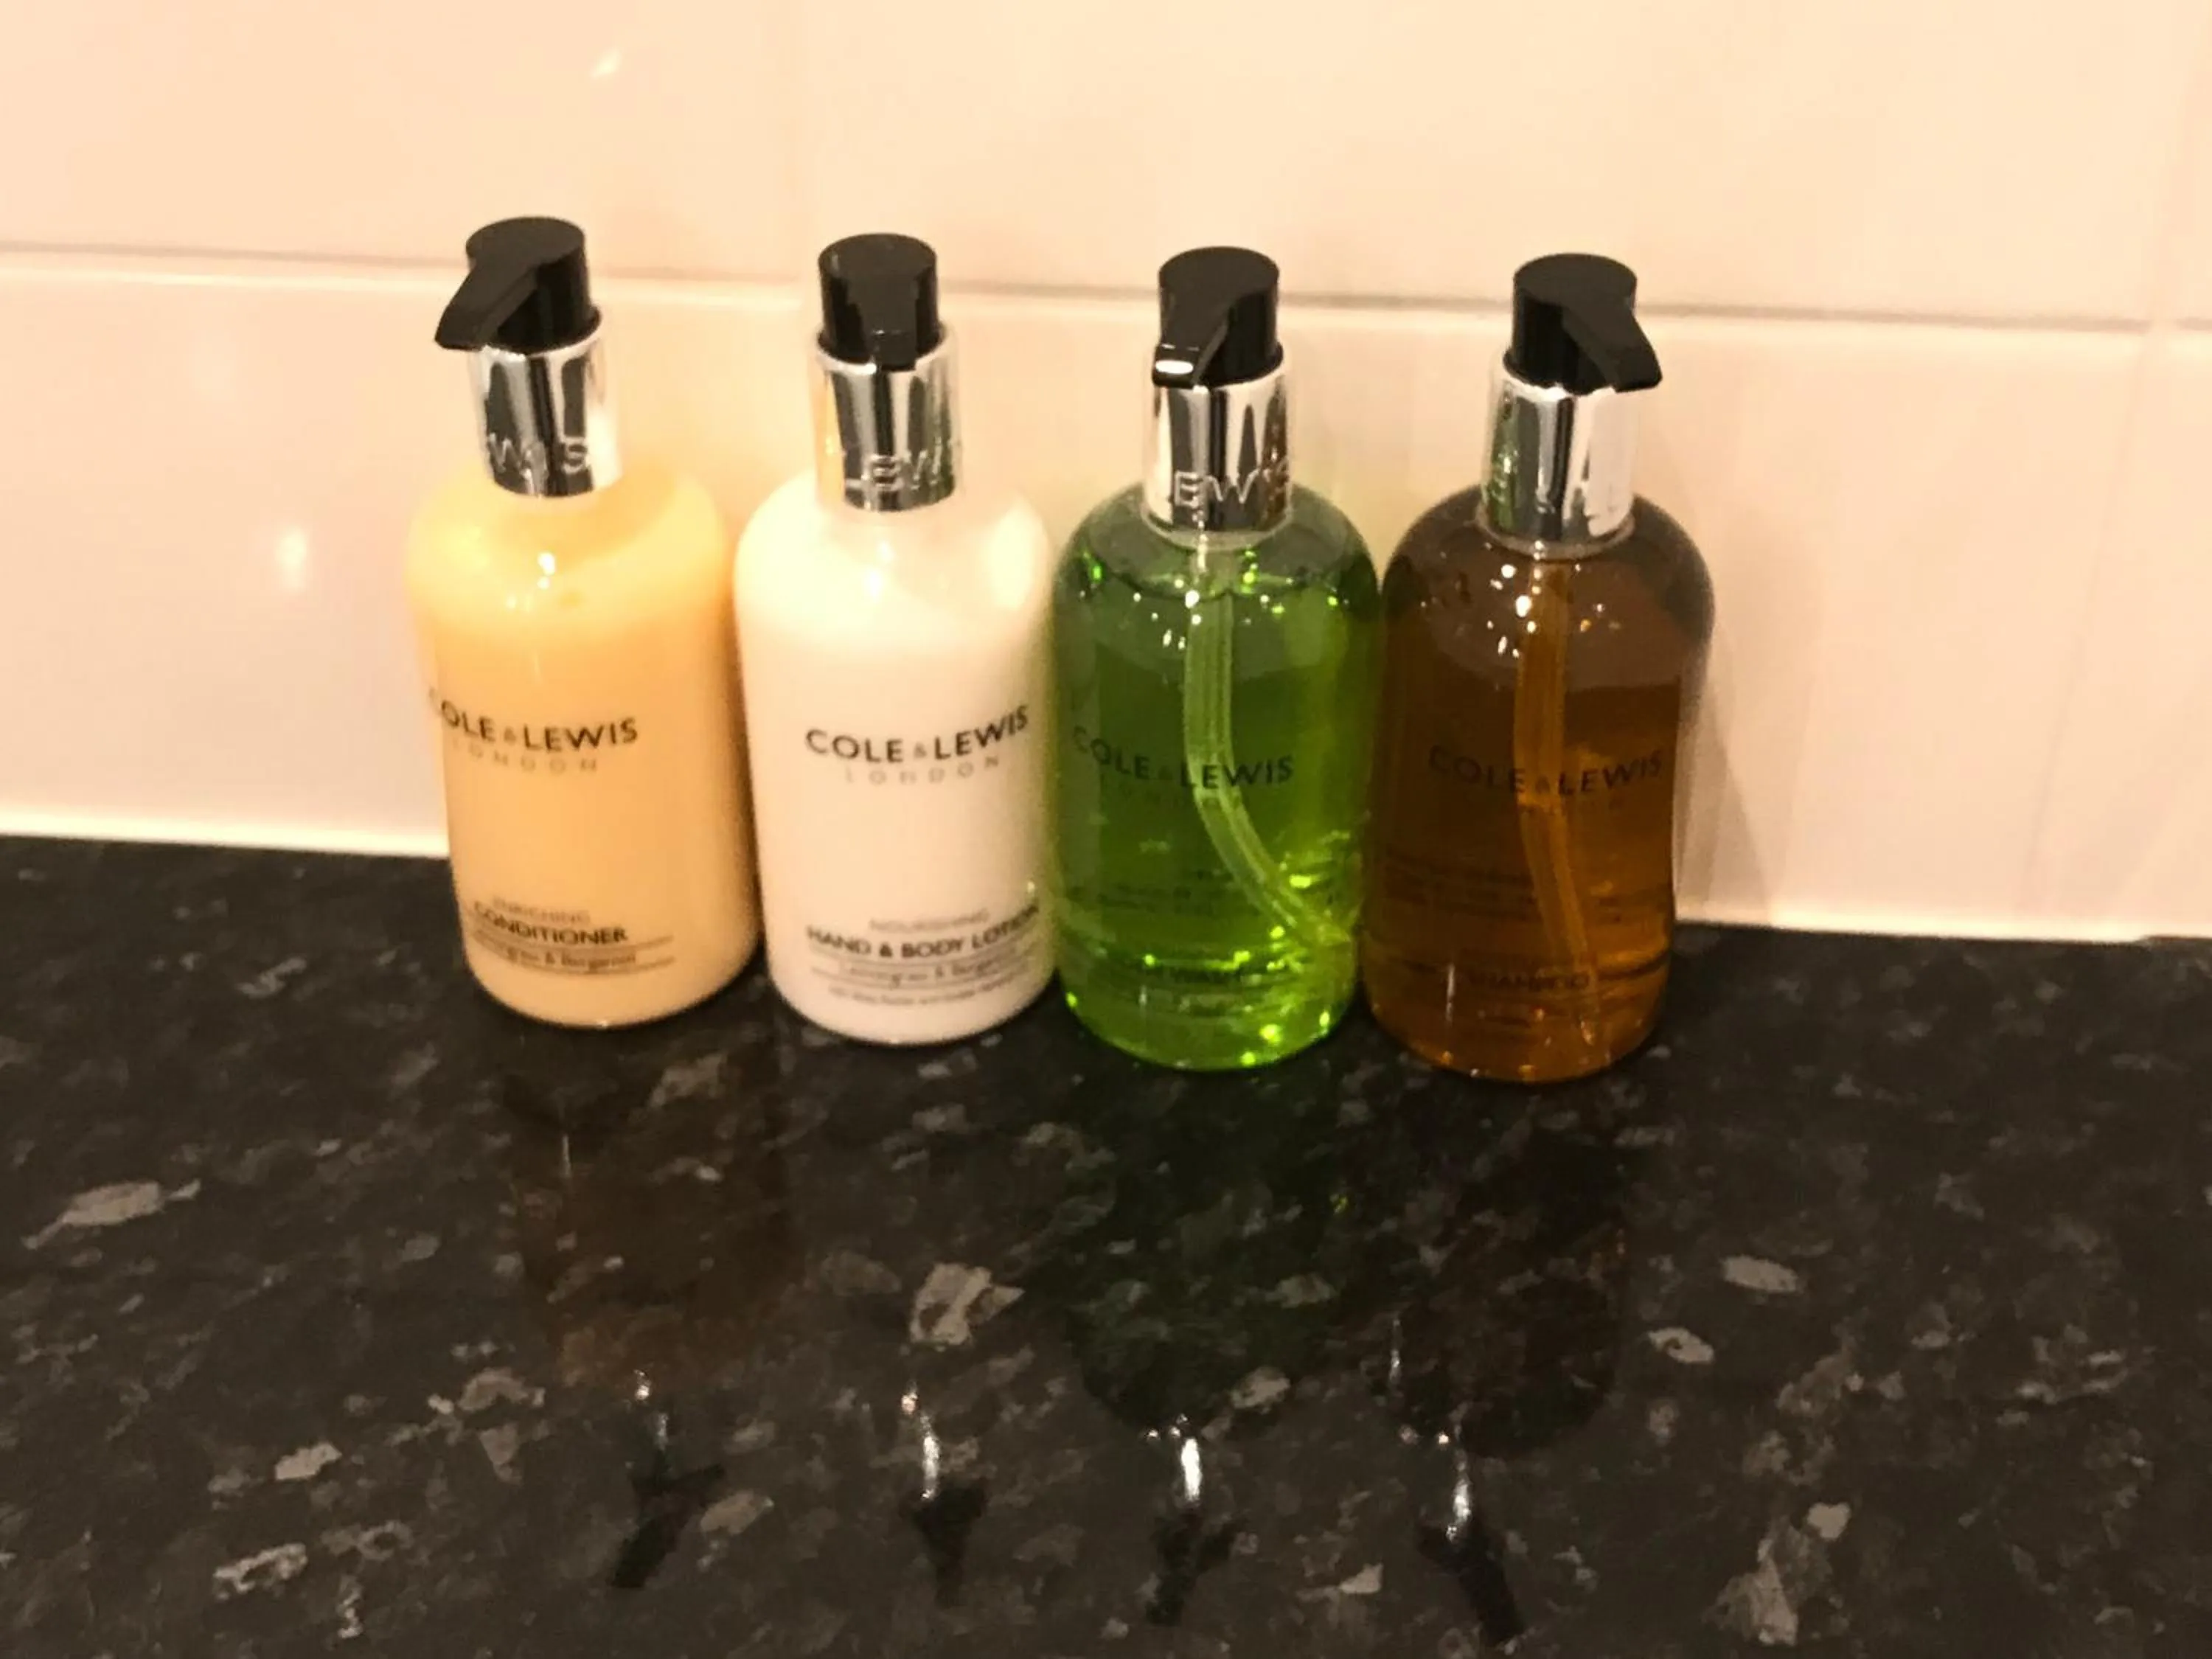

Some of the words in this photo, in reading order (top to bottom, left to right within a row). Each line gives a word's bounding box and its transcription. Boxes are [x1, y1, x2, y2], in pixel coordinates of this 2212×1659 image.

[522, 716, 639, 754] LEWIS
[805, 728, 904, 763] COLE
[933, 705, 1029, 760] LEWIS
[1072, 725, 1150, 781] COLE
[1180, 754, 1295, 790] LEWIS
[1427, 744, 1526, 794] COLE
[1558, 748, 1663, 796] LEWIS
[473, 900, 628, 945] CONDITIONER
[805, 925, 872, 956] HAND
[879, 941, 893, 959] &
[901, 937, 965, 959] BODY
